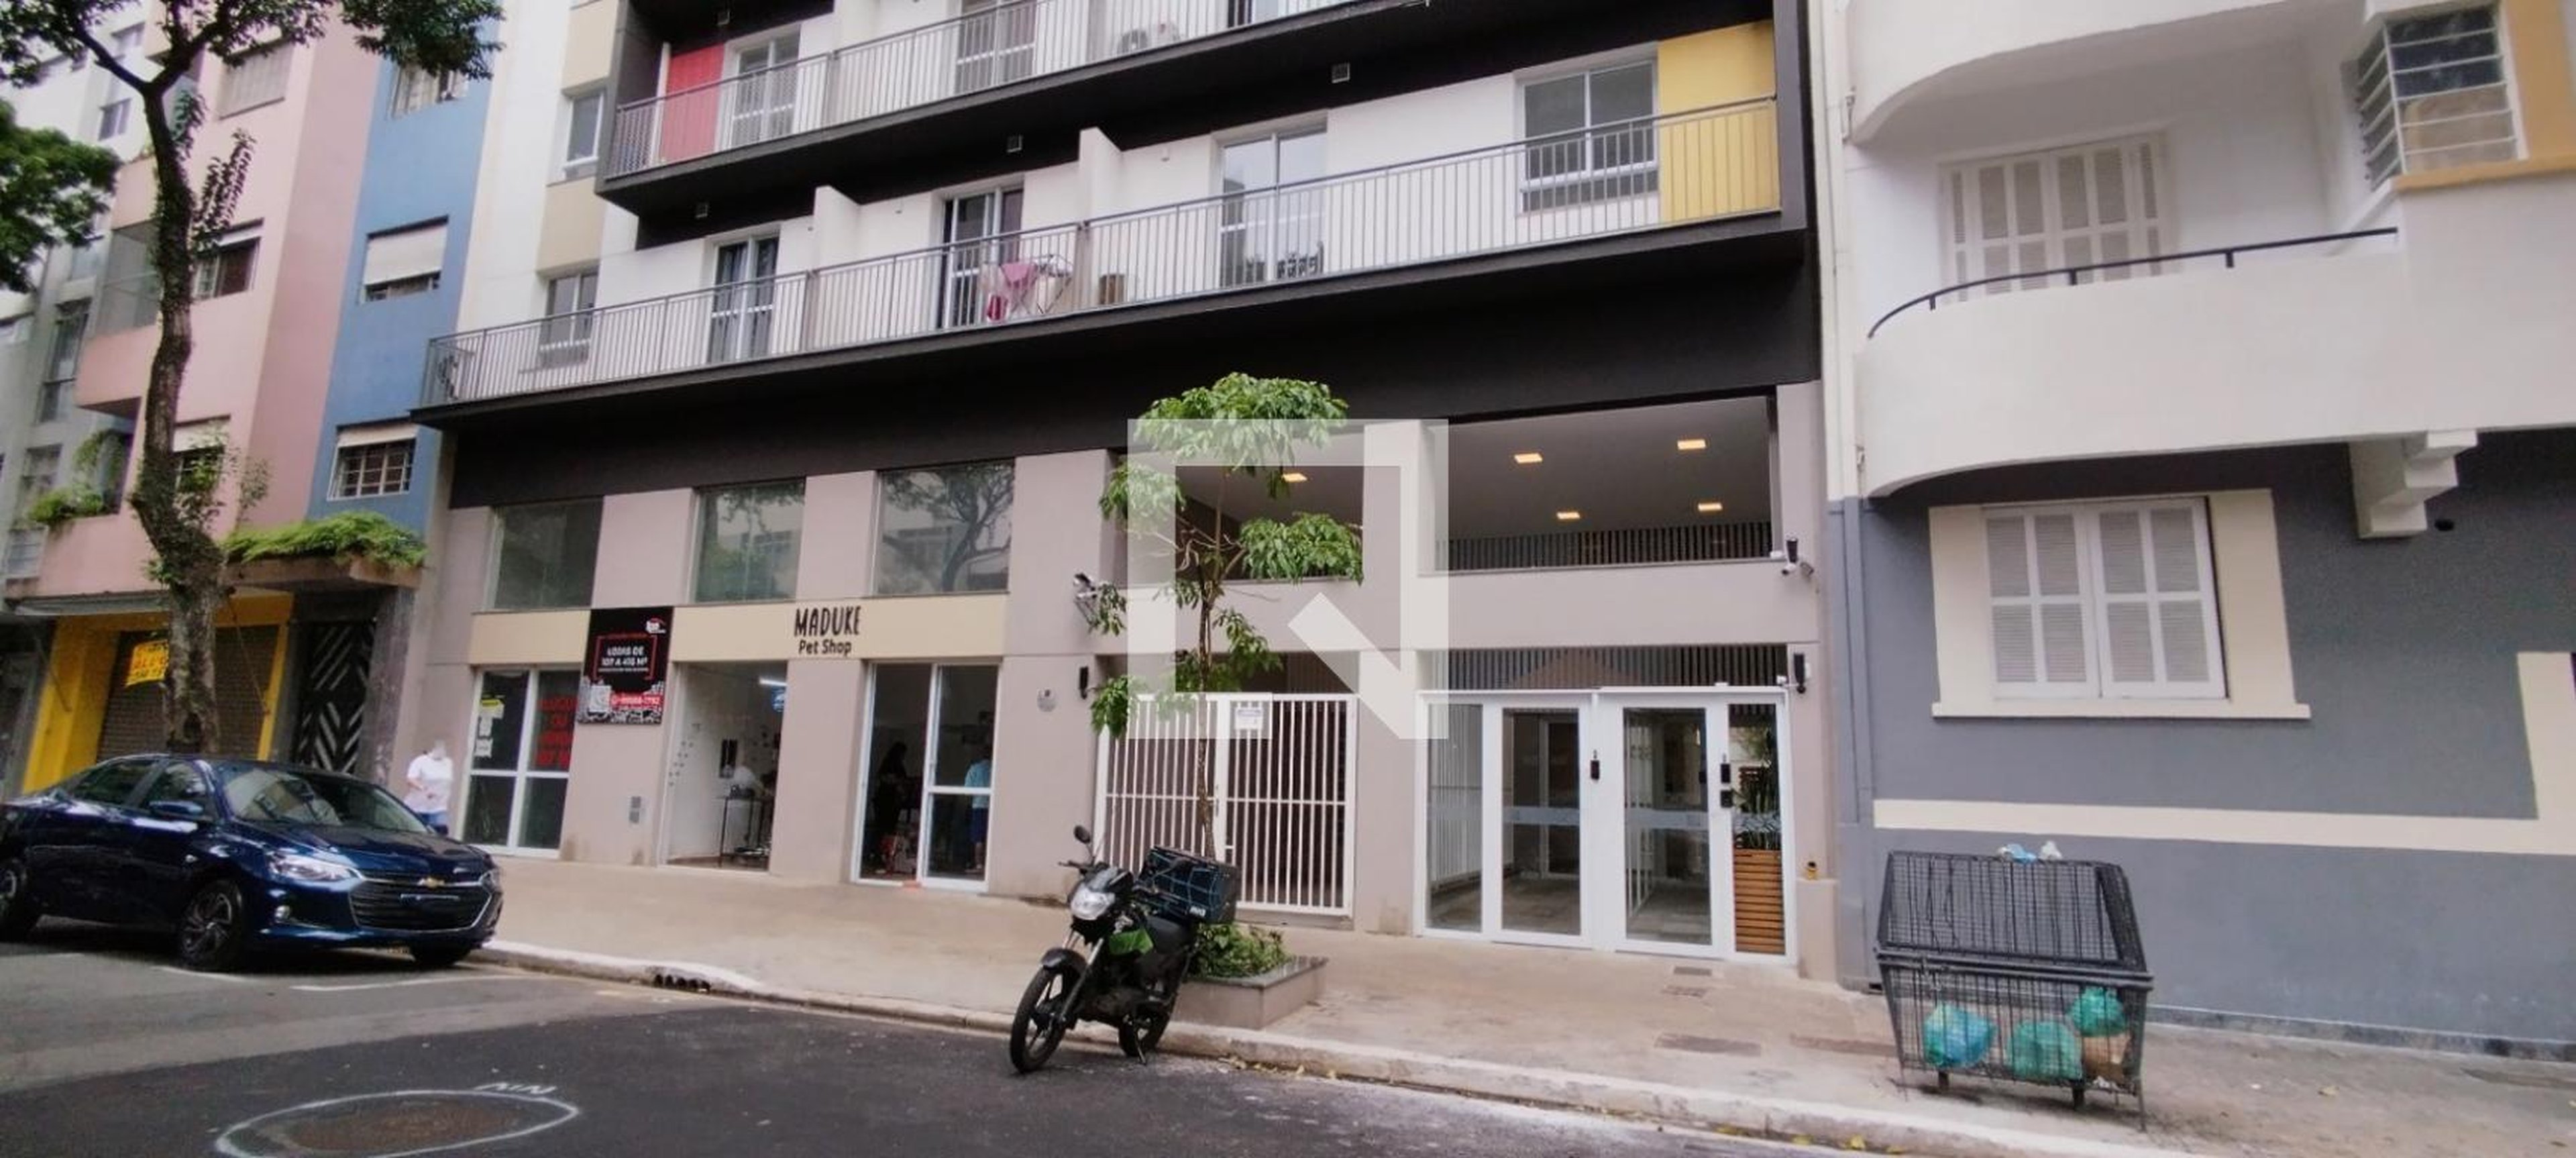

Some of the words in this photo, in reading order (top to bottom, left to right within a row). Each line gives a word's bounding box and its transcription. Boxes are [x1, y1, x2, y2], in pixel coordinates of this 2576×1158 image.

[794, 605, 861, 637] MADUKE
[798, 639, 818, 655] Pet
[822, 639, 852, 657] Shop
